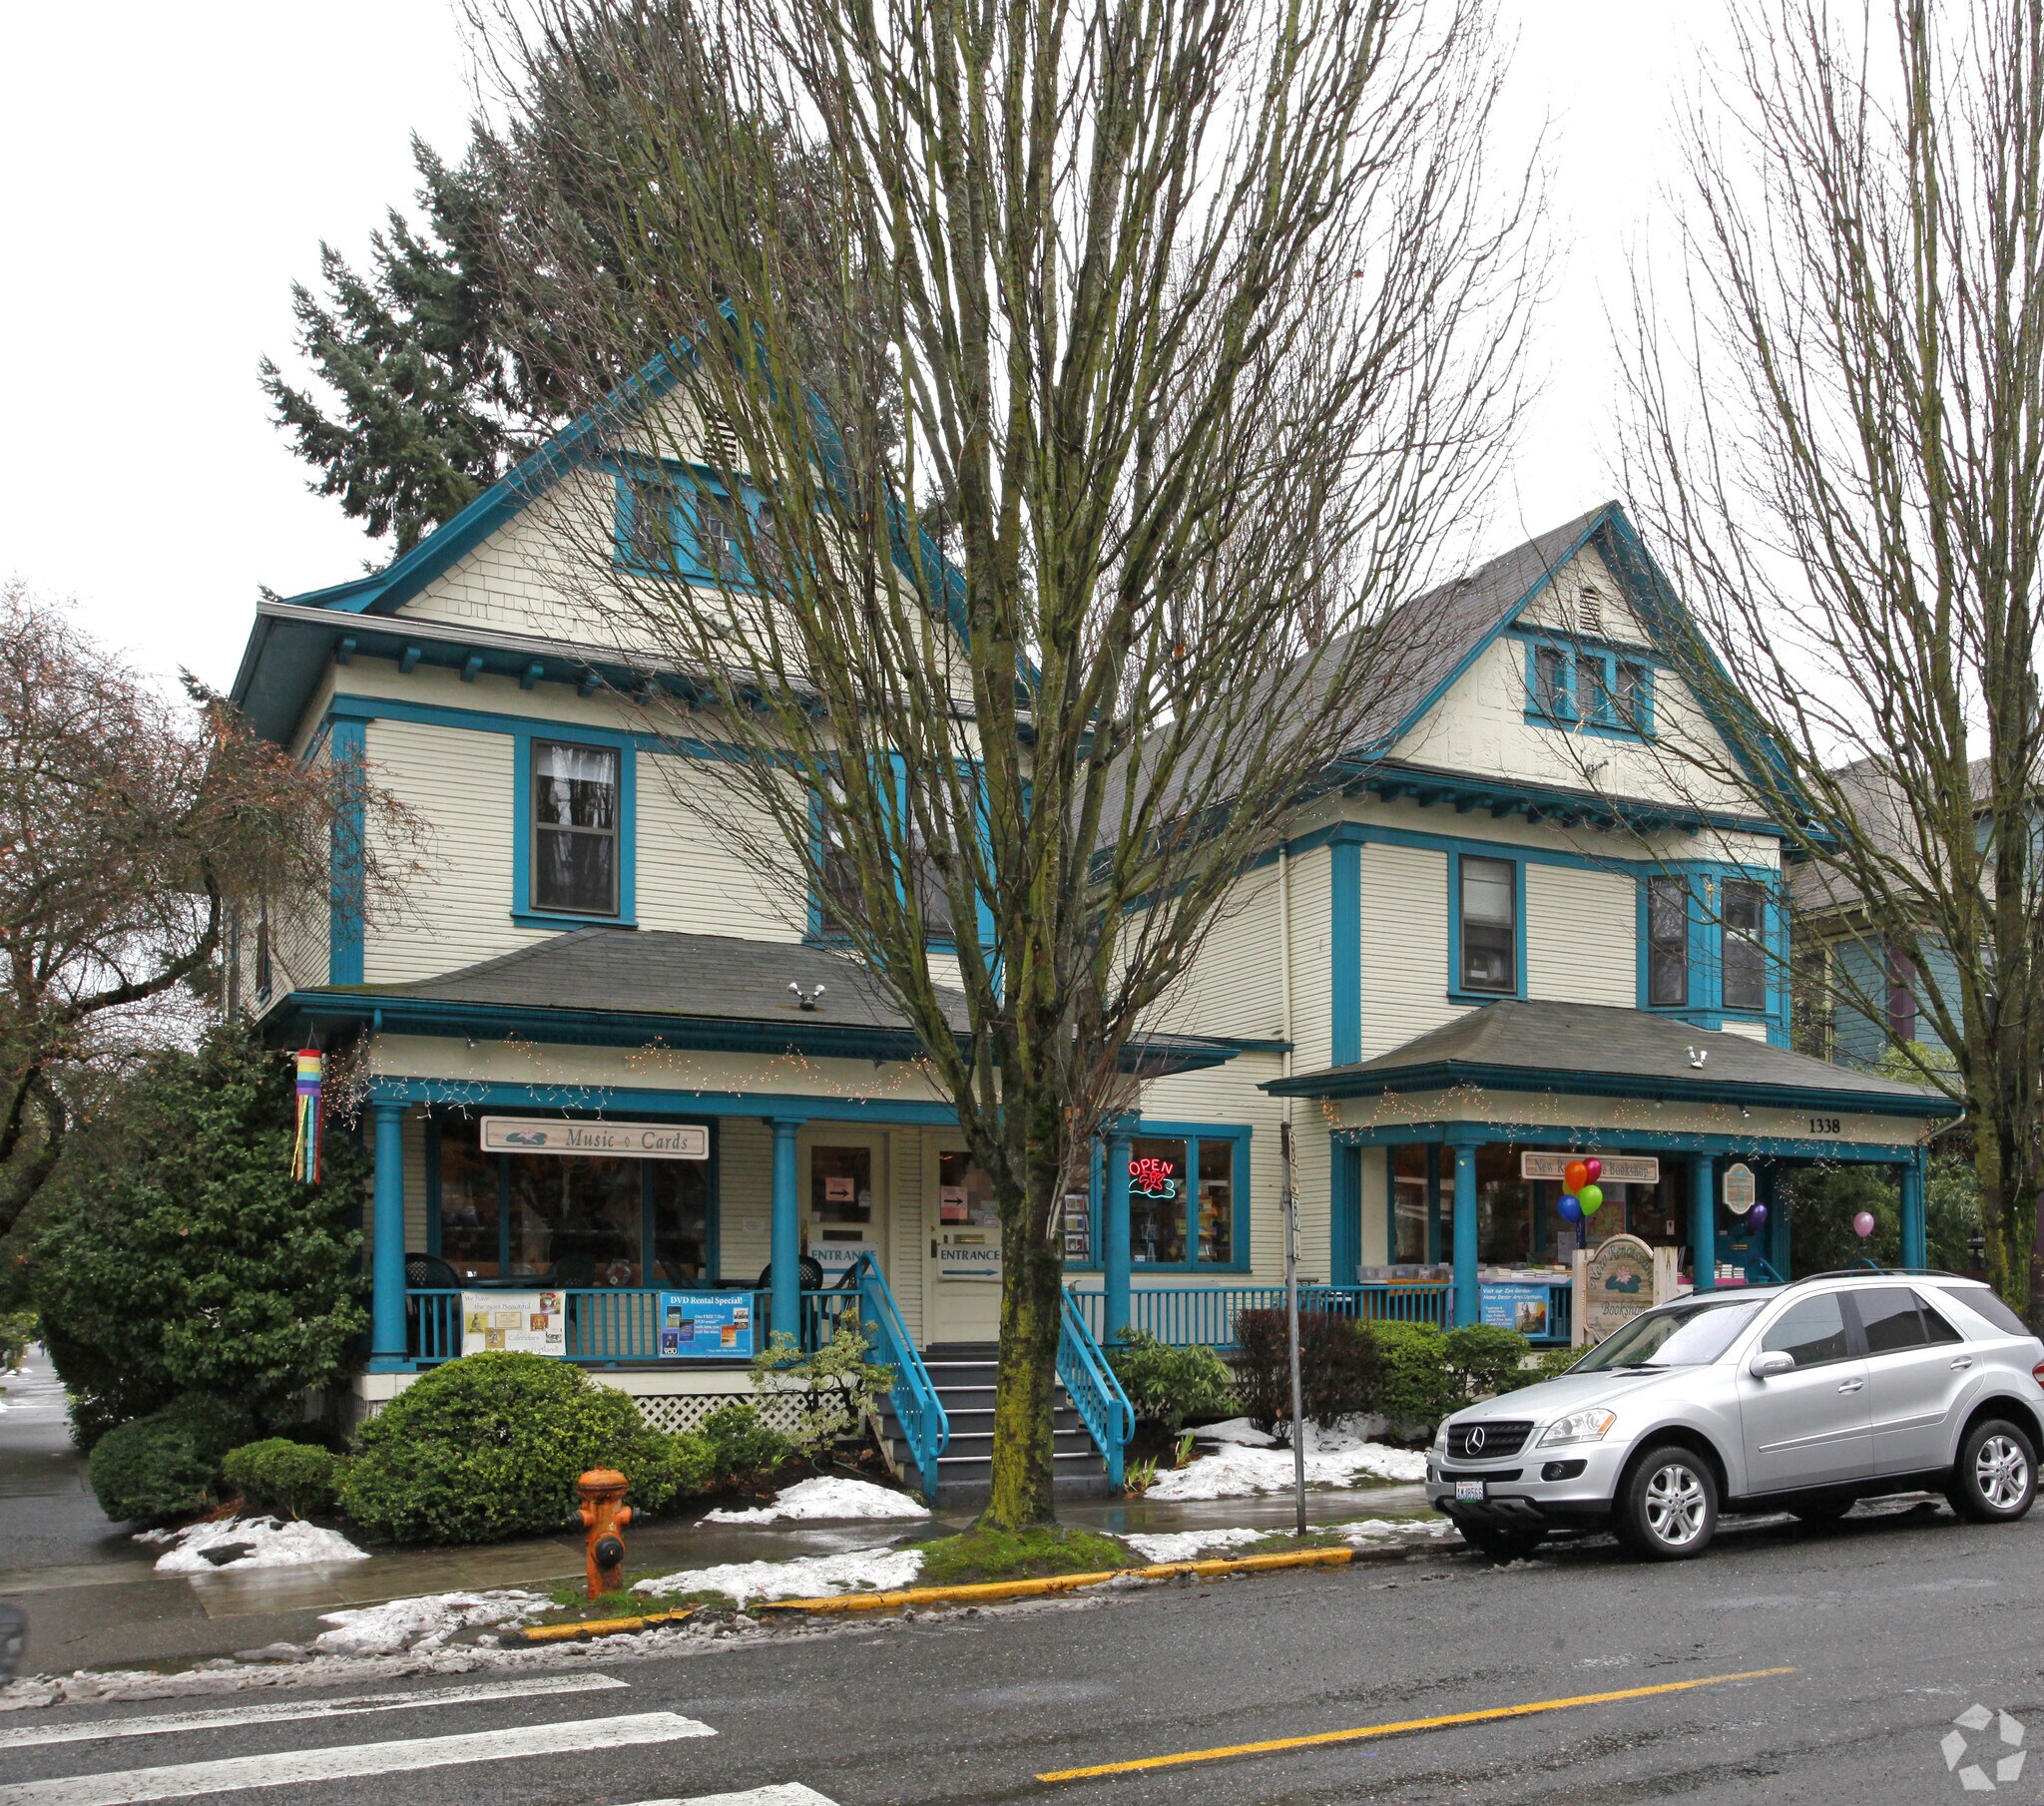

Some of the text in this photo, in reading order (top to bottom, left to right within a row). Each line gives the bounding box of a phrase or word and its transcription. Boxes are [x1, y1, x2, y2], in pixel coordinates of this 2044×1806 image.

[1809, 1119, 1840, 1133] 1338
[565, 1129, 688, 1150] Music Cards
[1129, 1158, 1174, 1175] OPEN
[1534, 1158, 1553, 1173] New
[1609, 1161, 1649, 1179] Bookshop
[811, 1249, 877, 1261] ENTRANE
[940, 1249, 1000, 1261] ENTRANCE
[715, 1296, 743, 1306] Special!
